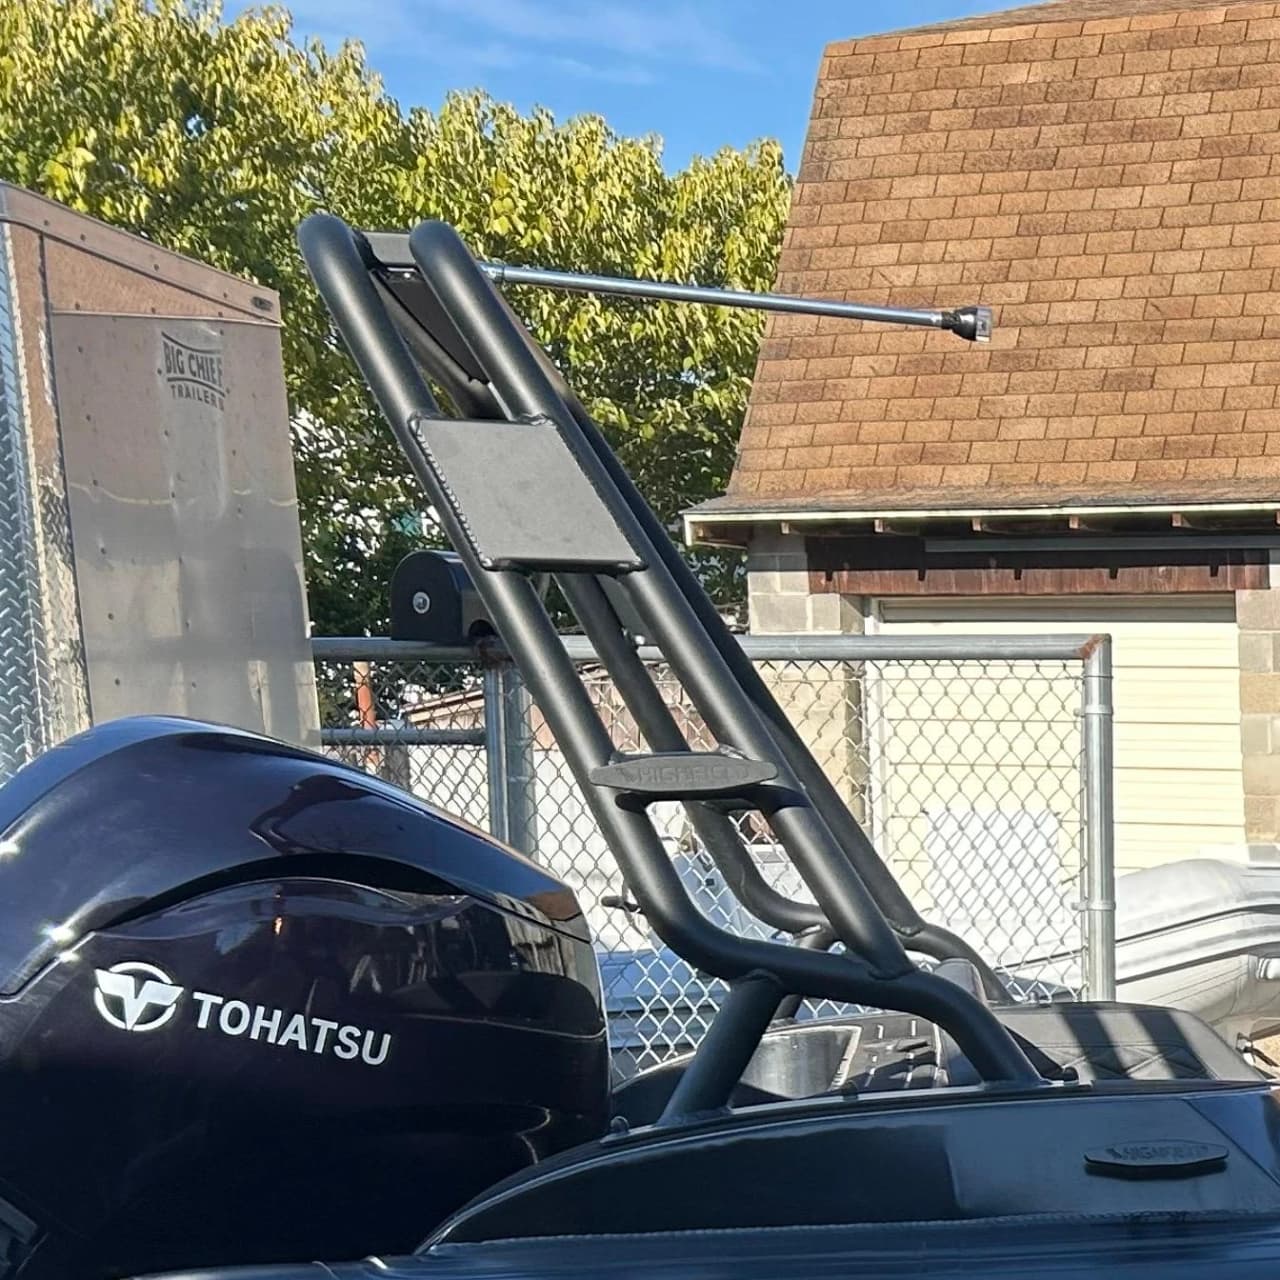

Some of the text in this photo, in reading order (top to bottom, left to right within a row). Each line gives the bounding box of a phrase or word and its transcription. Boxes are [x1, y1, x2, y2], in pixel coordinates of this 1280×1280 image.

[163, 341, 222, 387] BIG CHIEF
[171, 384, 225, 411] TRAILERS
[193, 991, 391, 1066] TOHATSU
